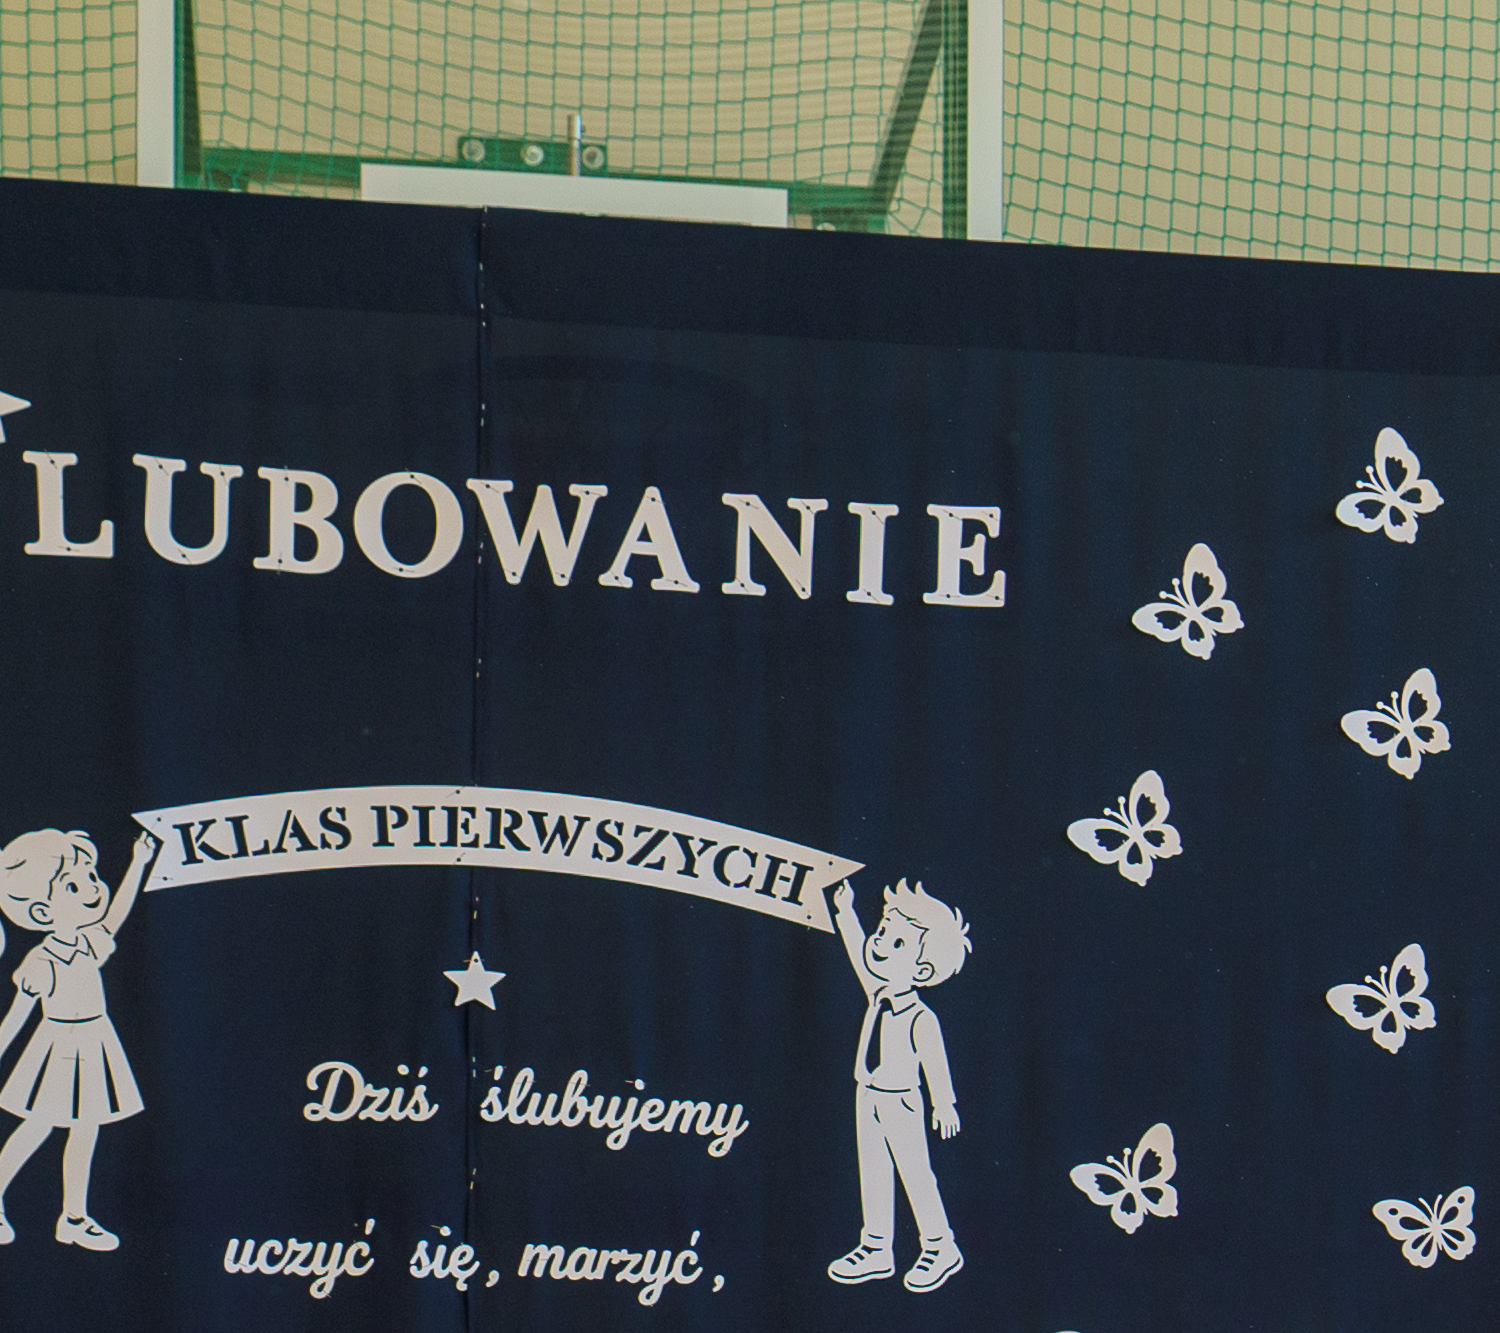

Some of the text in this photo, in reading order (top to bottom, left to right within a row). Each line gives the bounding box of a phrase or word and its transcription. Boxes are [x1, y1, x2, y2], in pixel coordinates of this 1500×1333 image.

[172, 805, 814, 906] KLAS PIERWSZYCH
[303, 1060, 750, 1158] Dziś ślubujemy
[223, 1217, 376, 1300] uczyć
